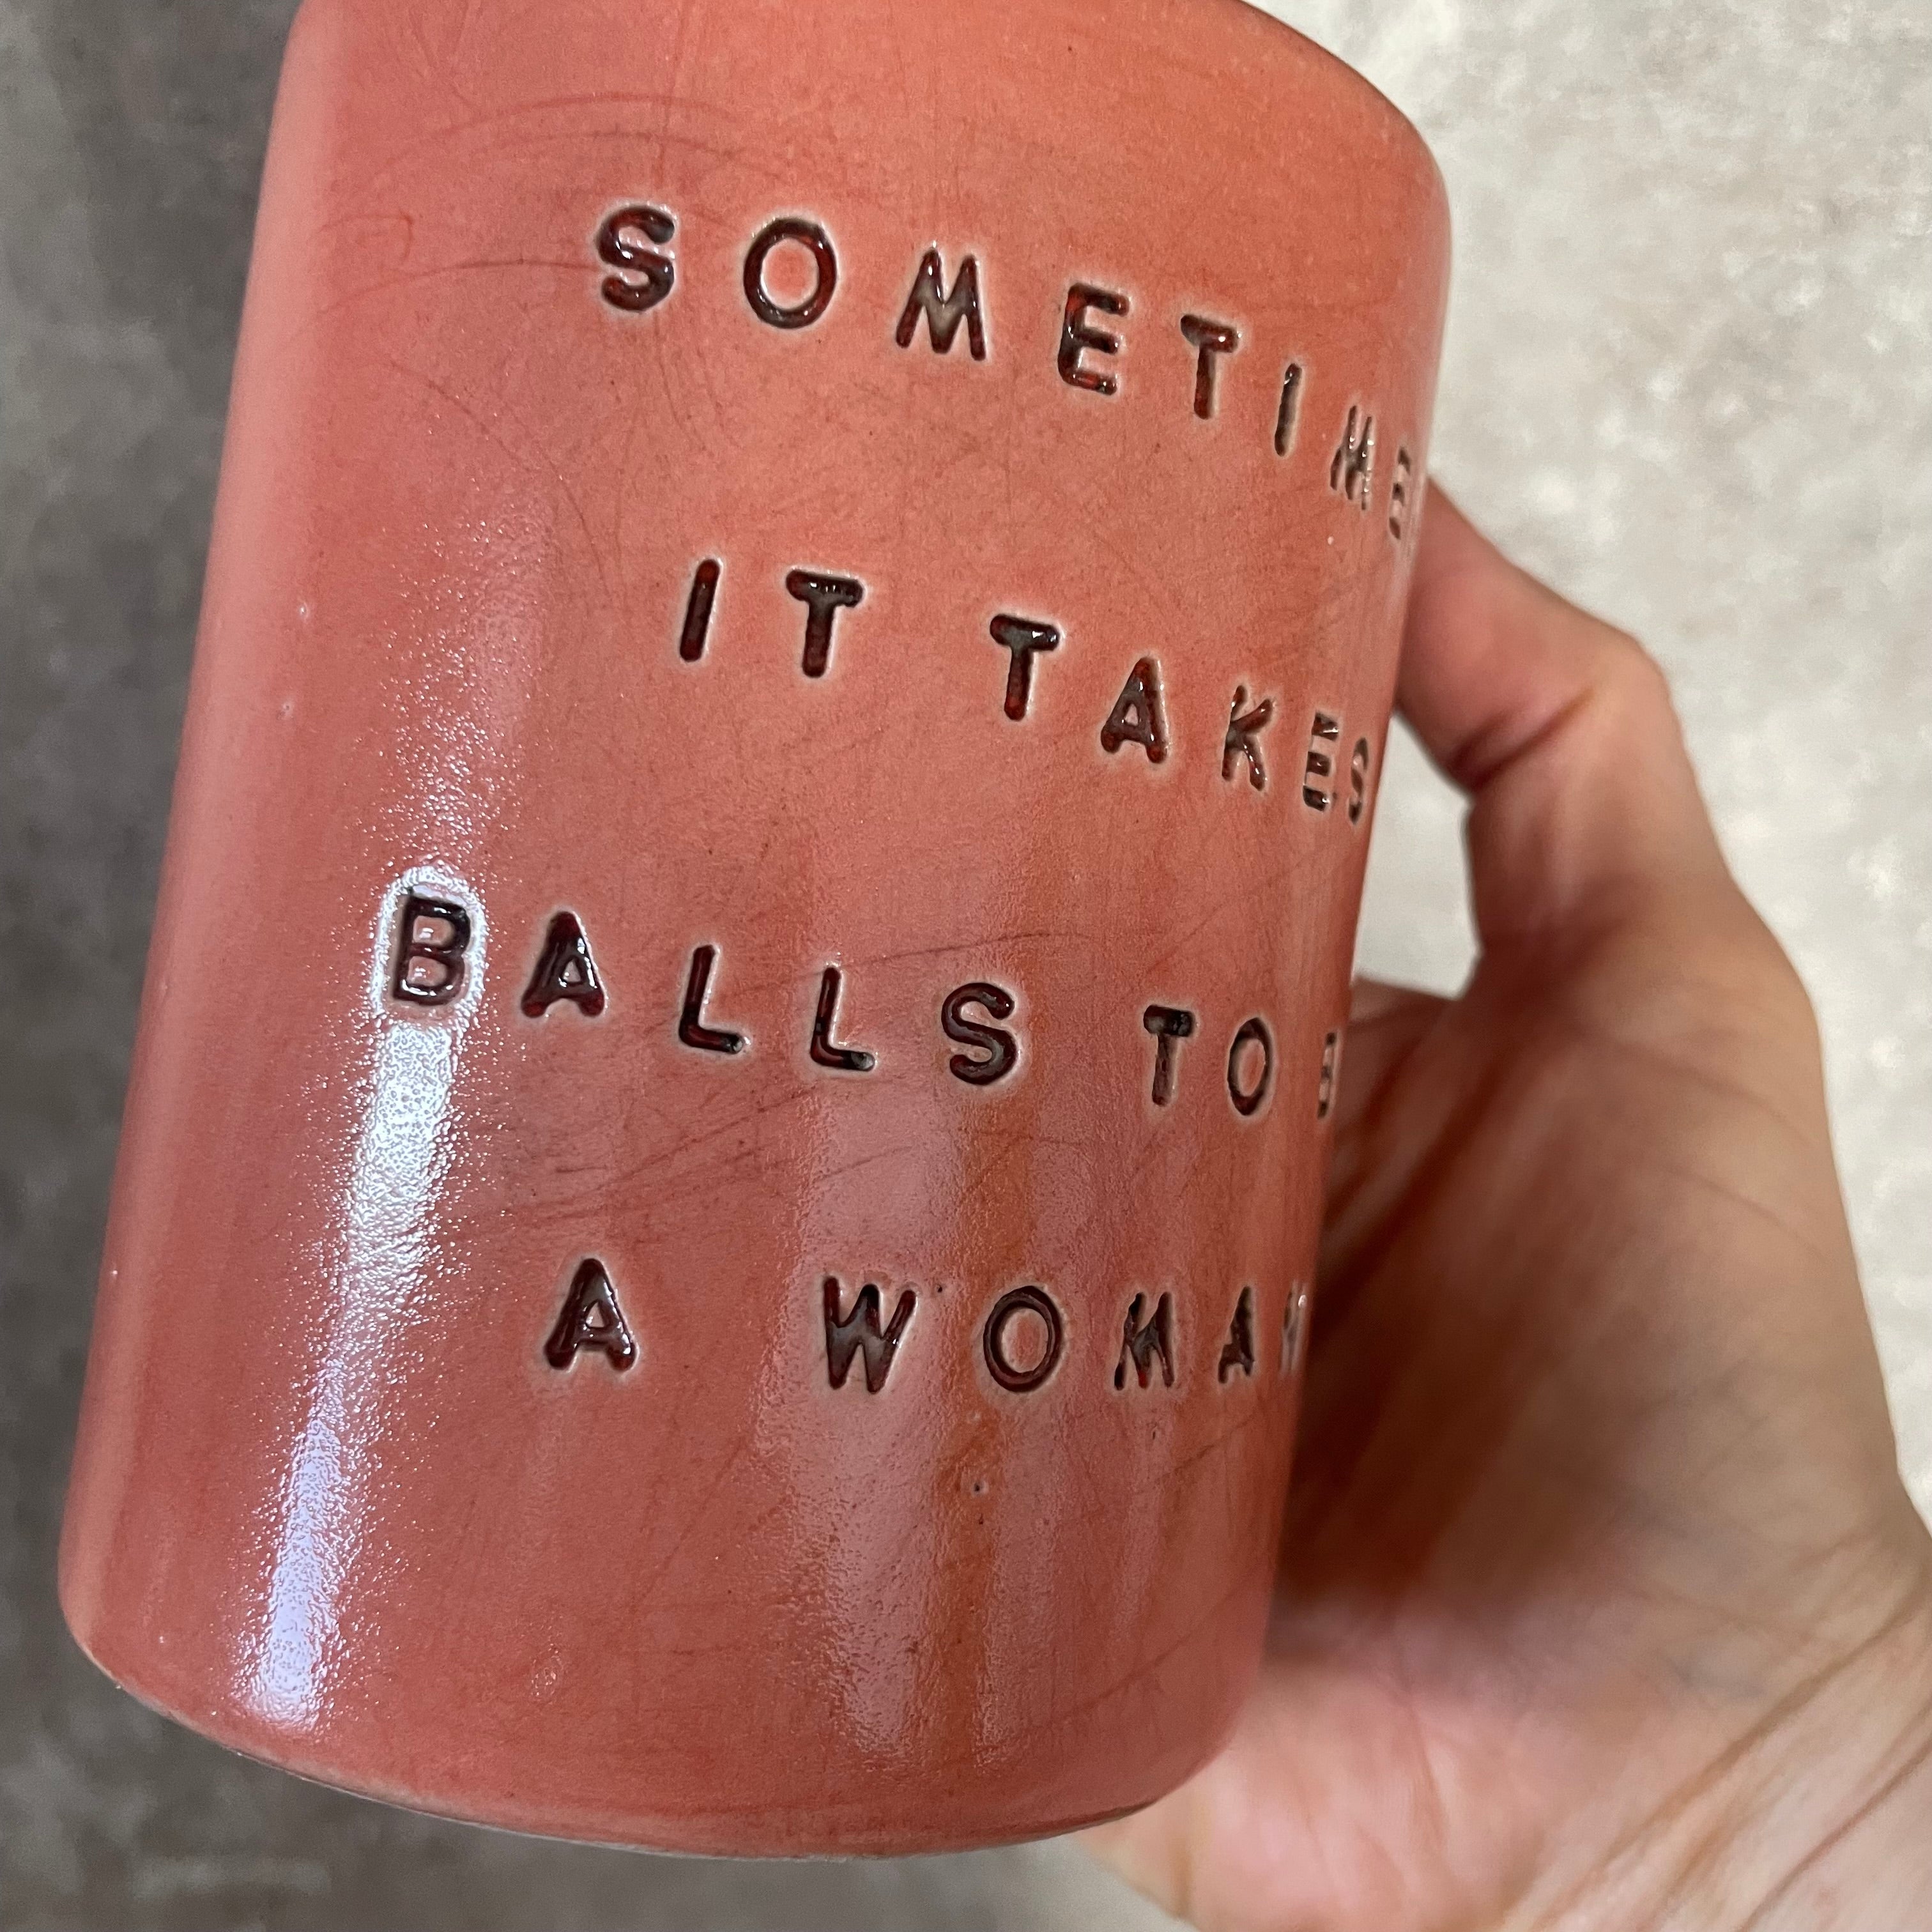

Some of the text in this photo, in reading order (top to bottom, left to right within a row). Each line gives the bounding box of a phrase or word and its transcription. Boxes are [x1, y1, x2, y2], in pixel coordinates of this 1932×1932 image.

[679, 558, 1370, 825] IT TAKES
[390, 887, 1019, 1085] BALLS
[1143, 1004, 1274, 1117] TO
[544, 1259, 637, 1371] A
